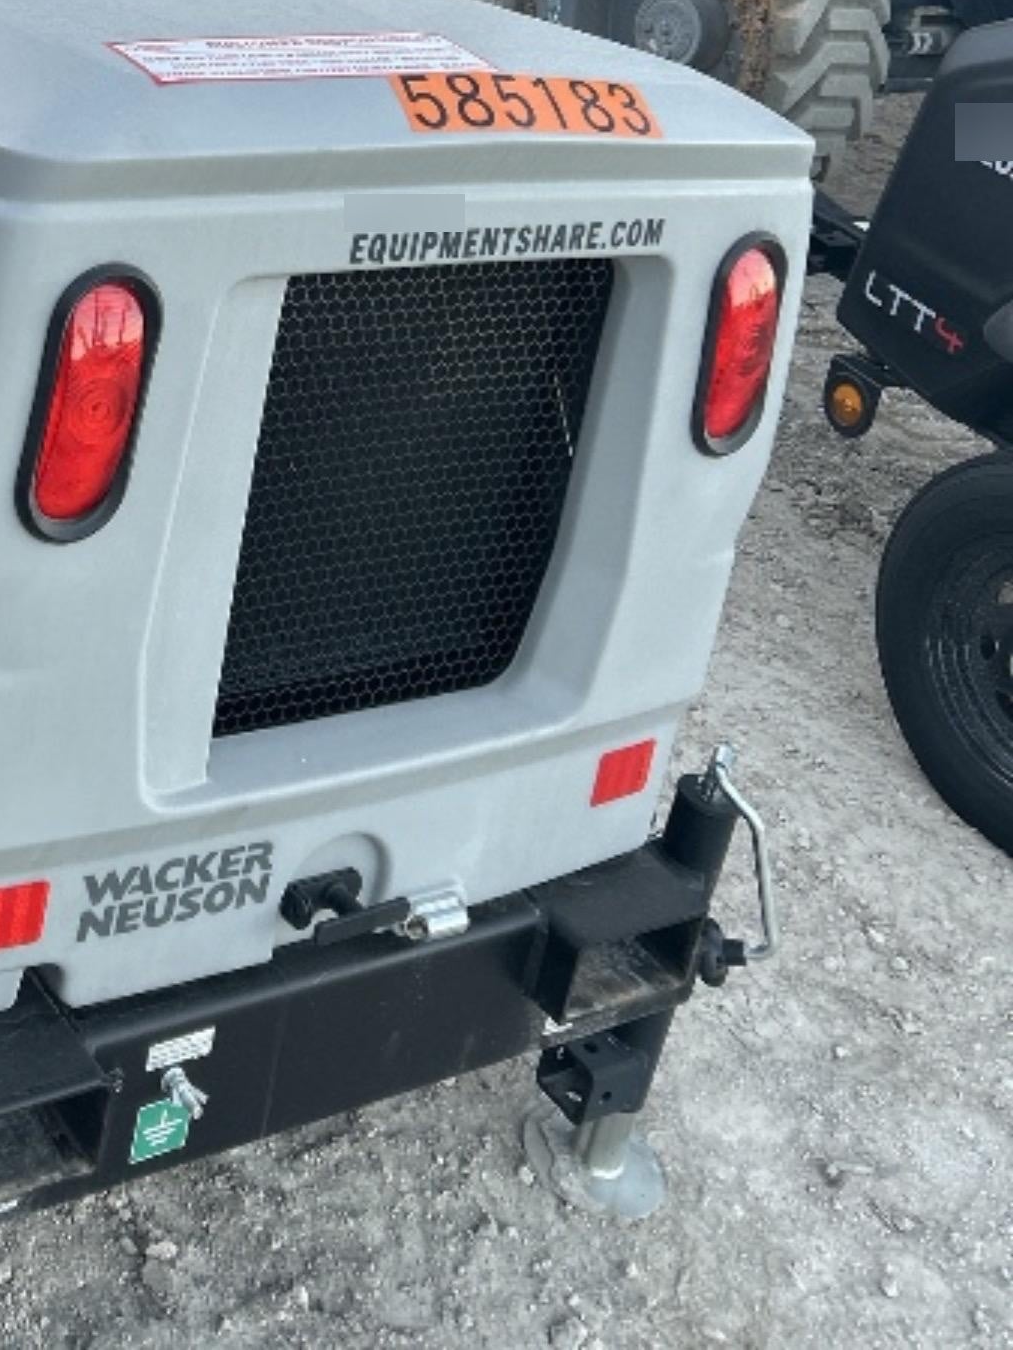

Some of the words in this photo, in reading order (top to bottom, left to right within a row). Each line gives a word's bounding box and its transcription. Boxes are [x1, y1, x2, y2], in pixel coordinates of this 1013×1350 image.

[399, 72, 652, 137] 585183
[348, 217, 667, 265] EQUIPMENTSHARE.COM
[82, 840, 274, 907] WACKER
[76, 872, 271, 943] NEUSON
